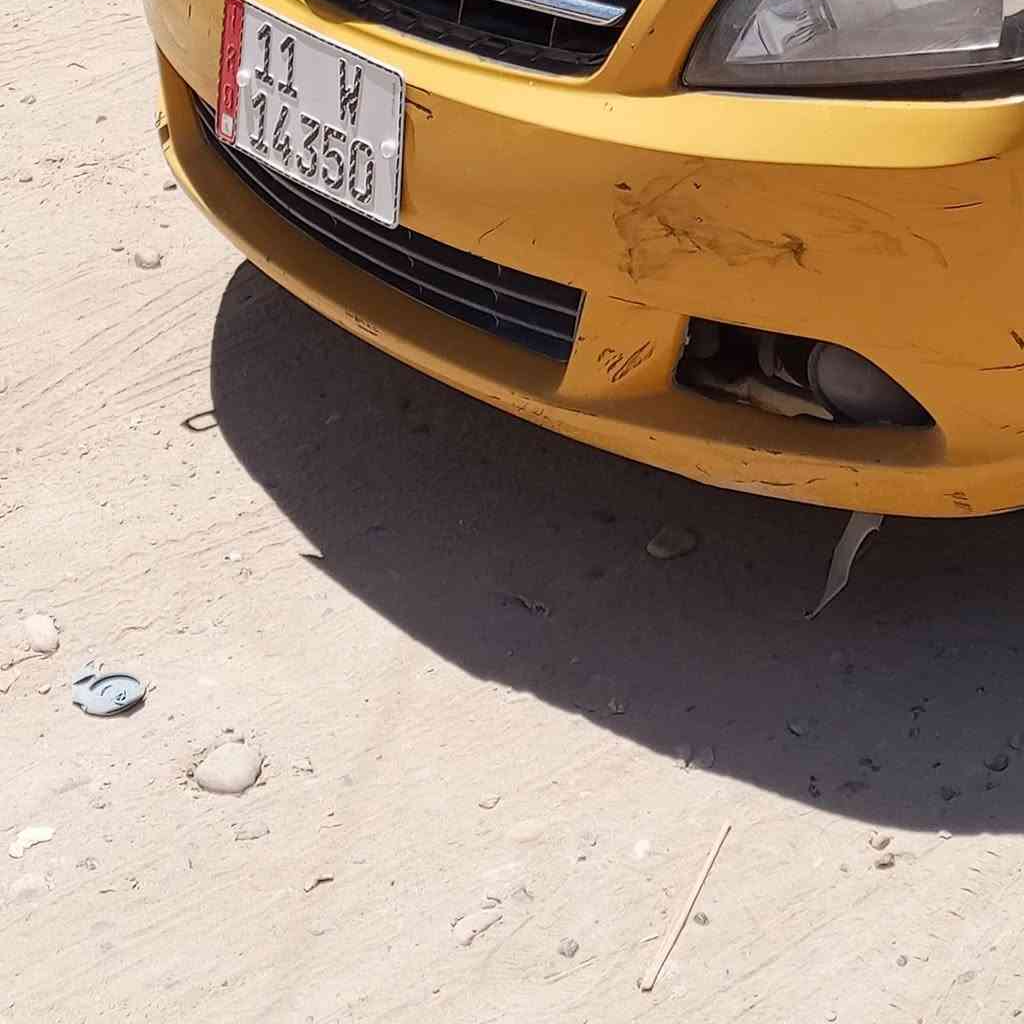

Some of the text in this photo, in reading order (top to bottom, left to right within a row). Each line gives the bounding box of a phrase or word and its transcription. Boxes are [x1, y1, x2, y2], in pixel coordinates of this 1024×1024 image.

[253, 23, 362, 125] 11 W
[249, 91, 374, 204] 14350
